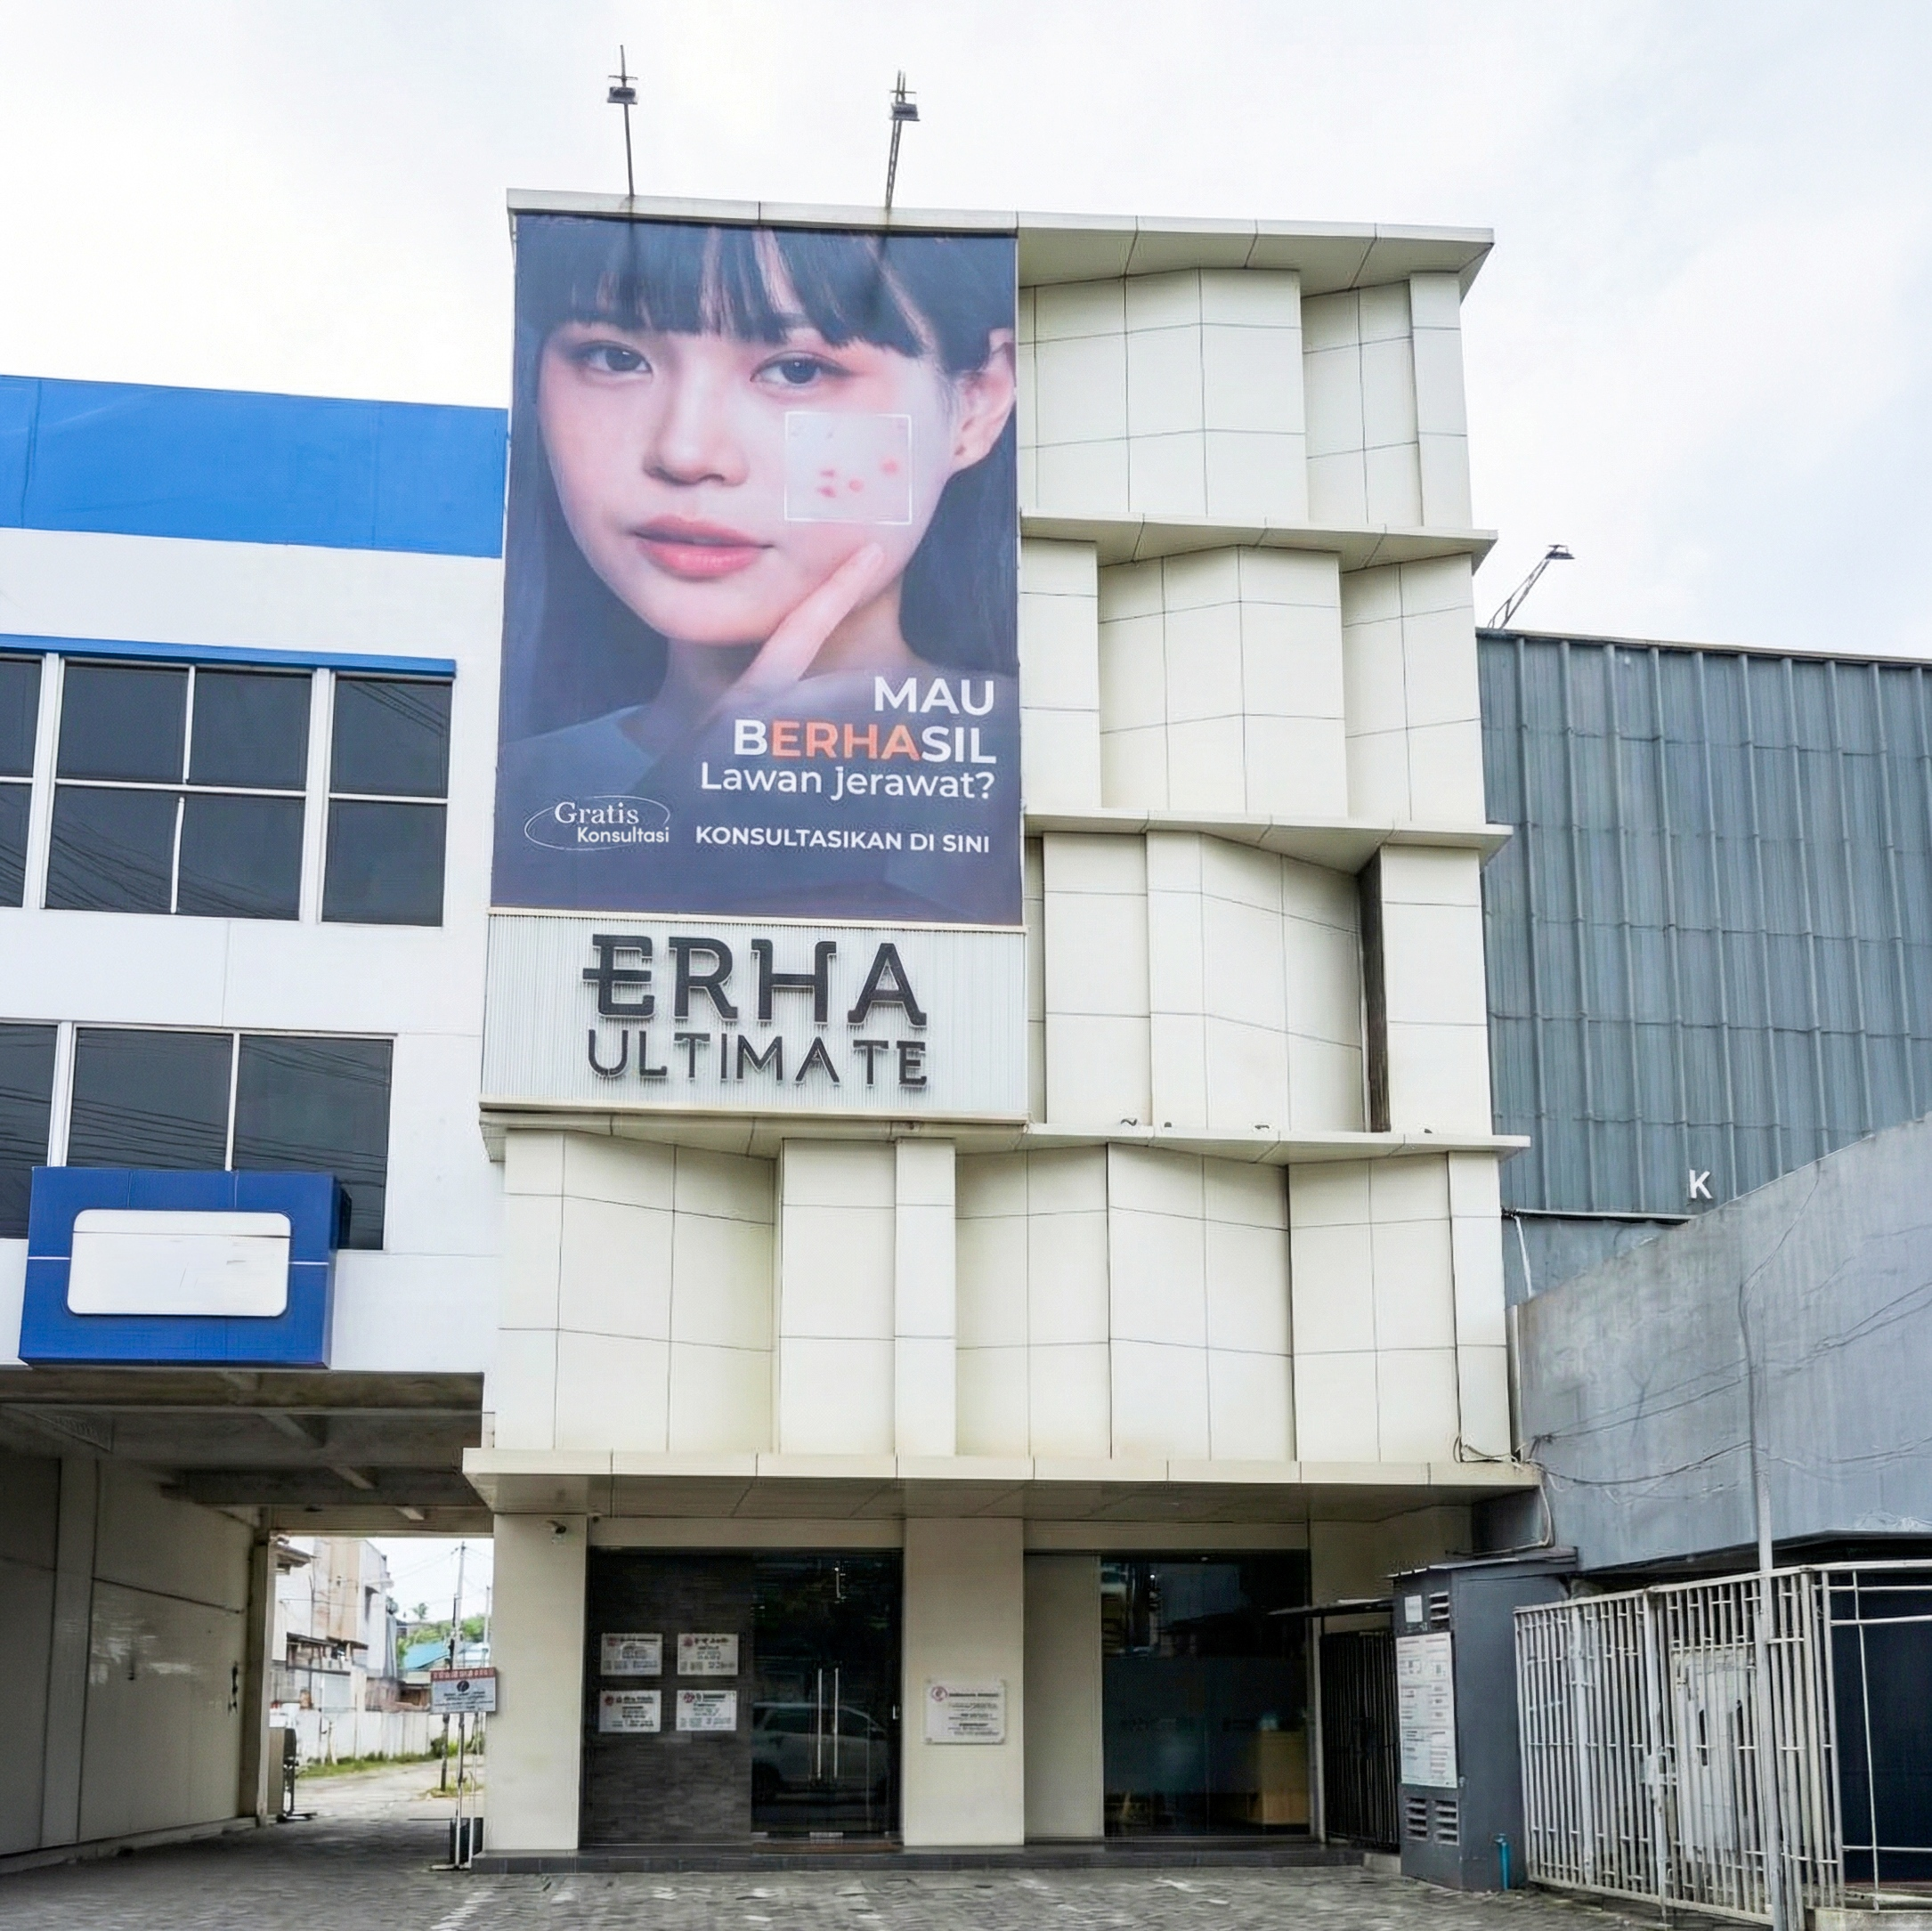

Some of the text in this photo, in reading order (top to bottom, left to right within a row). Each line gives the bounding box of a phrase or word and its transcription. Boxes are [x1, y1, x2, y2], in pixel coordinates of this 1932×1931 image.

[874, 677, 994, 715] MAU
[735, 720, 996, 764] BERHASIL
[701, 761, 994, 800] Lawan jerawat?
[555, 801, 639, 824] Gratis
[577, 825, 670, 844] Konsultasi
[695, 826, 990, 853] KONSULTASIKAN DI SINI
[583, 935, 927, 1026] ERHA
[589, 1030, 928, 1085] ULTIMATE
[1689, 1169, 1713, 1199] K
